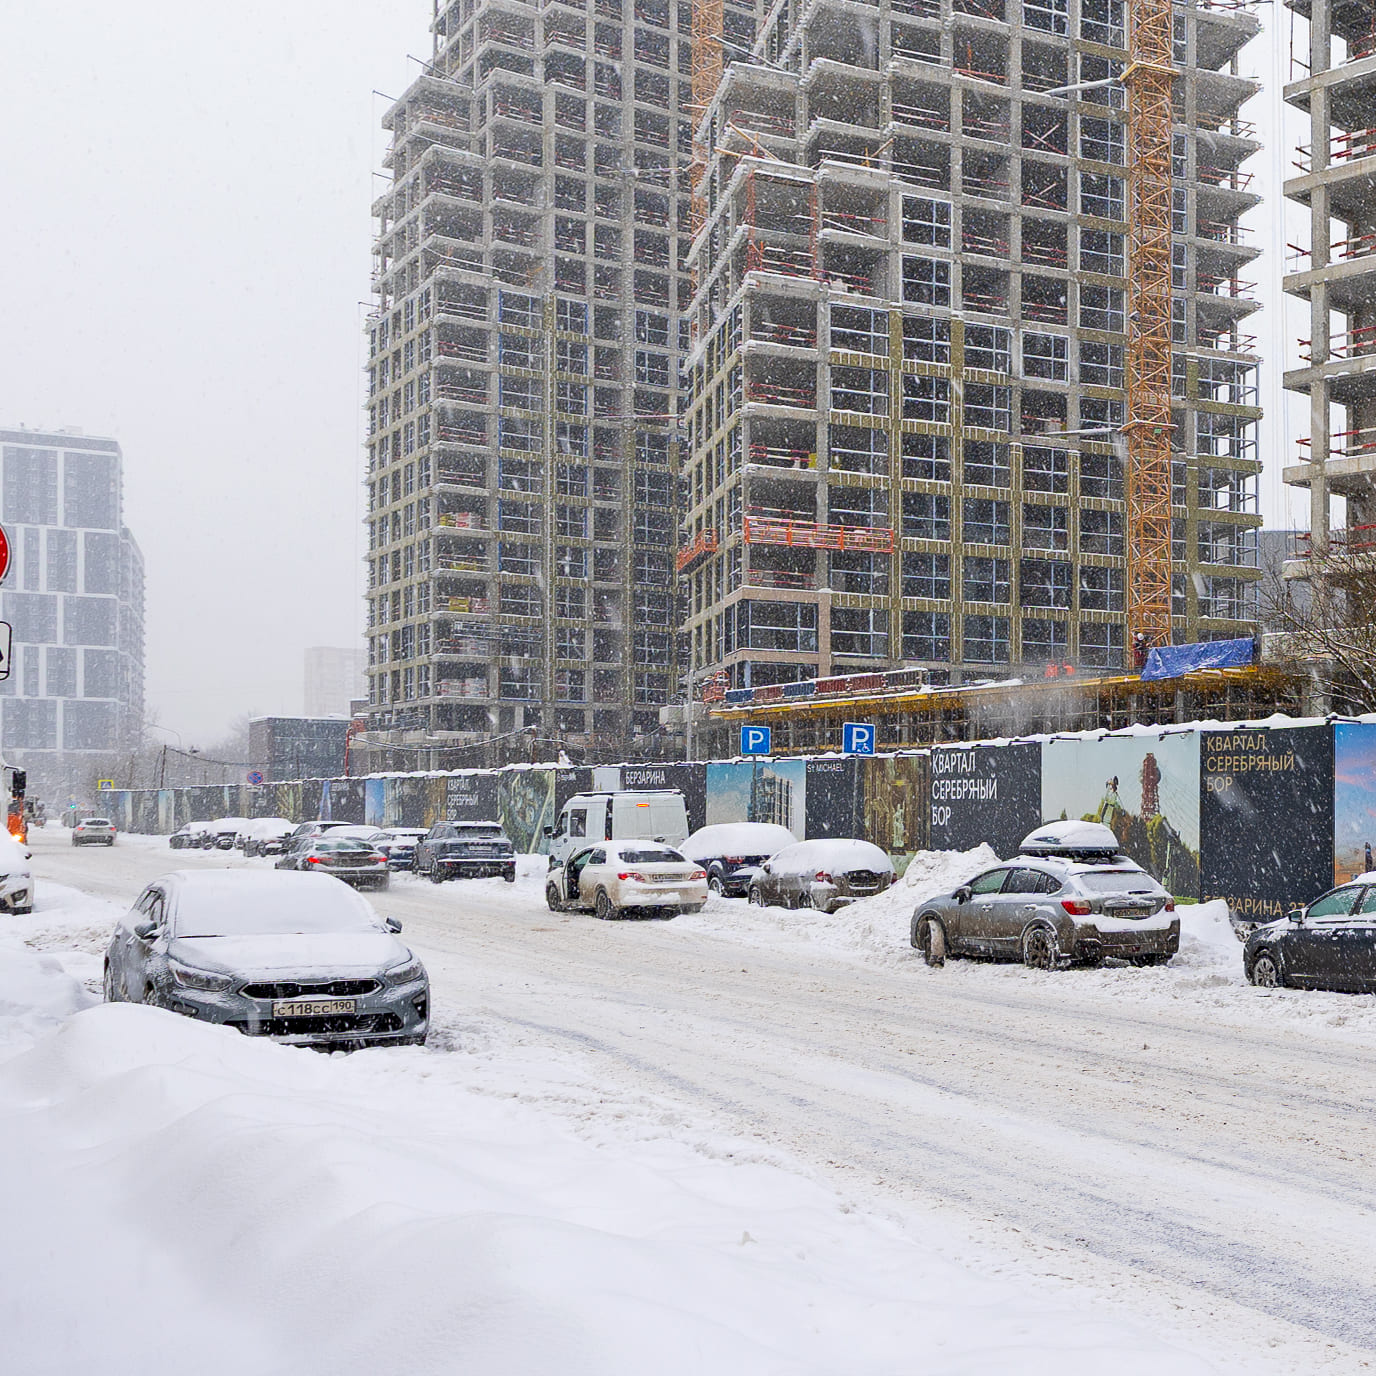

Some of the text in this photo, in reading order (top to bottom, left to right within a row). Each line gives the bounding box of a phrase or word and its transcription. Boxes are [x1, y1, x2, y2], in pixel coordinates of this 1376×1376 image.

[1206, 735, 1266, 752] КВАРТАЛ
[932, 751, 976, 773] КВАРТАЛ
[1206, 751, 1294, 772] СЕРЕБРЯНЫЙ
[625, 770, 666, 785] БЕРЗАРИНА
[932, 773, 998, 800] СЕРЕБРЯНЫЙ
[1206, 776, 1233, 792] БОР
[932, 806, 951, 825] БОР
[1204, 896, 1283, 916] ЗАРИНА
[332, 1001, 352, 1010] 190
